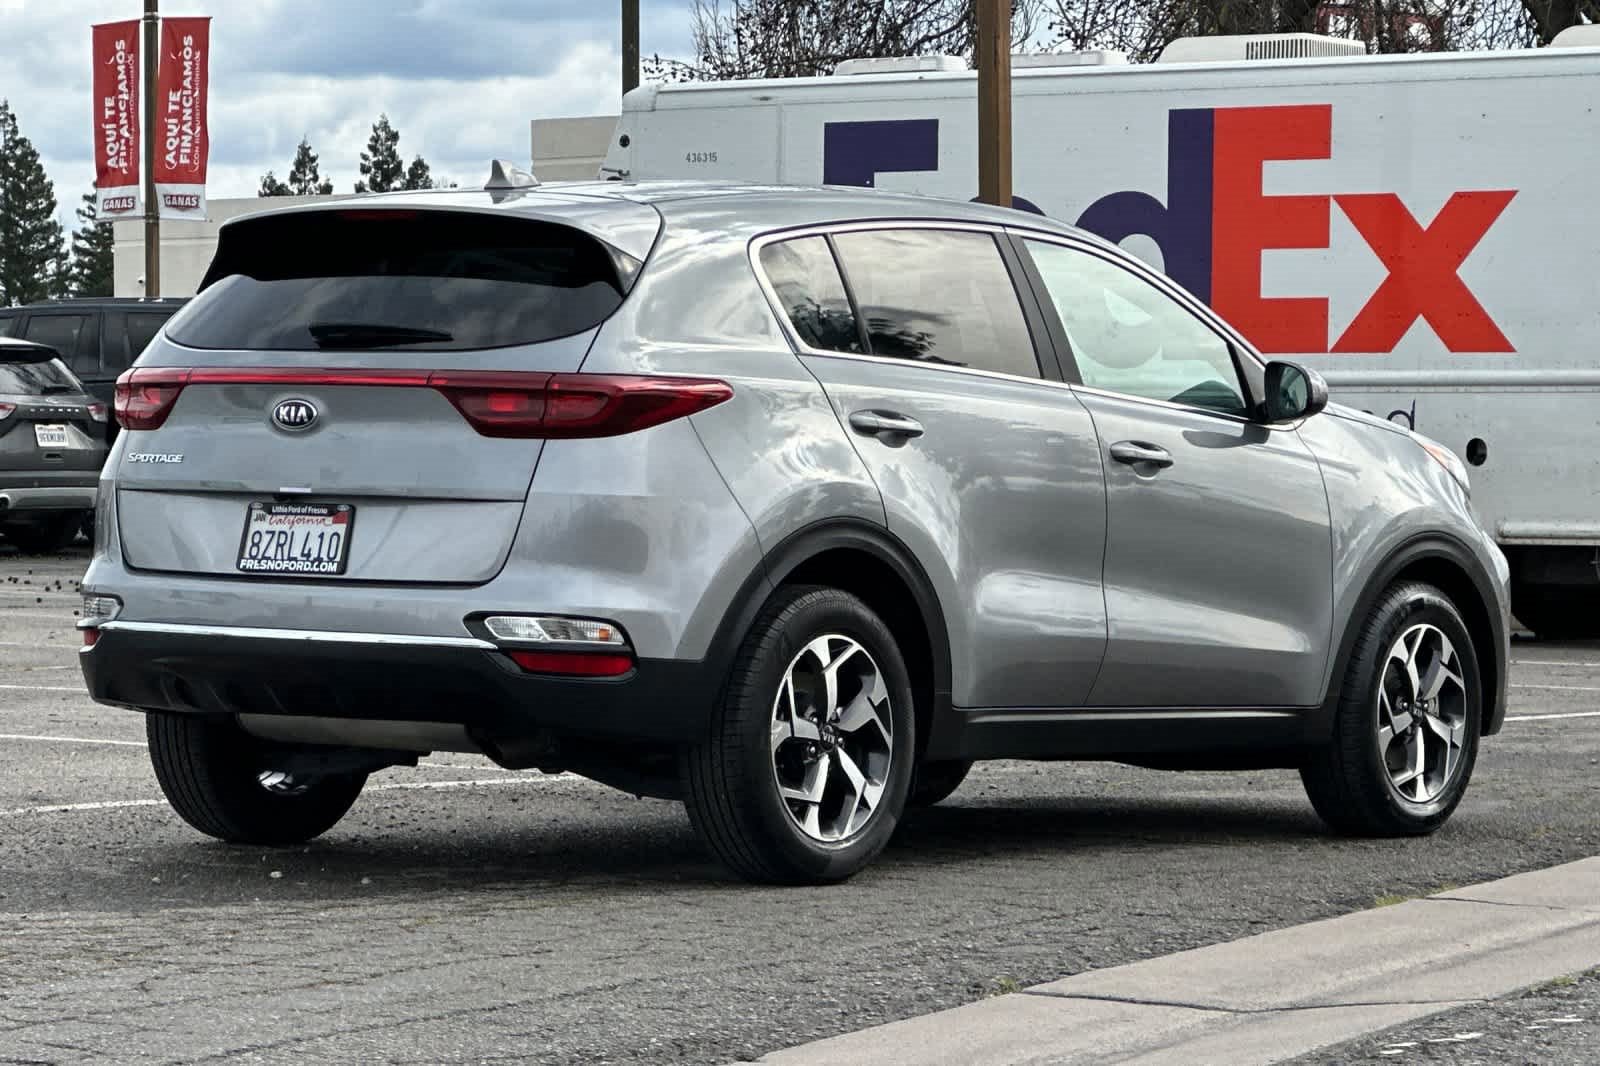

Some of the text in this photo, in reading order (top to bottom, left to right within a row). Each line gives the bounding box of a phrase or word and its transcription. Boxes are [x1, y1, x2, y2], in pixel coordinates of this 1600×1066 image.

[115, 39, 129, 168] FINANCIAMOS
[180, 34, 193, 165] FINANCIAMOS
[102, 96, 119, 168] AQUÍ TE
[164, 90, 181, 164] AQUÍ TE
[685, 151, 718, 163] 436315
[103, 198, 134, 210] GANAS
[165, 195, 198, 207] GANAS
[823, 104, 1519, 353] dEx
[279, 406, 308, 422] KIA
[128, 452, 184, 464] SPORTAGE
[288, 505, 300, 514] Ford
[301, 505, 308, 514] of
[308, 506, 328, 515] Fresno
[249, 530, 341, 561] 8ZRL410
[239, 559, 338, 572] FRESNOFORD.COM
